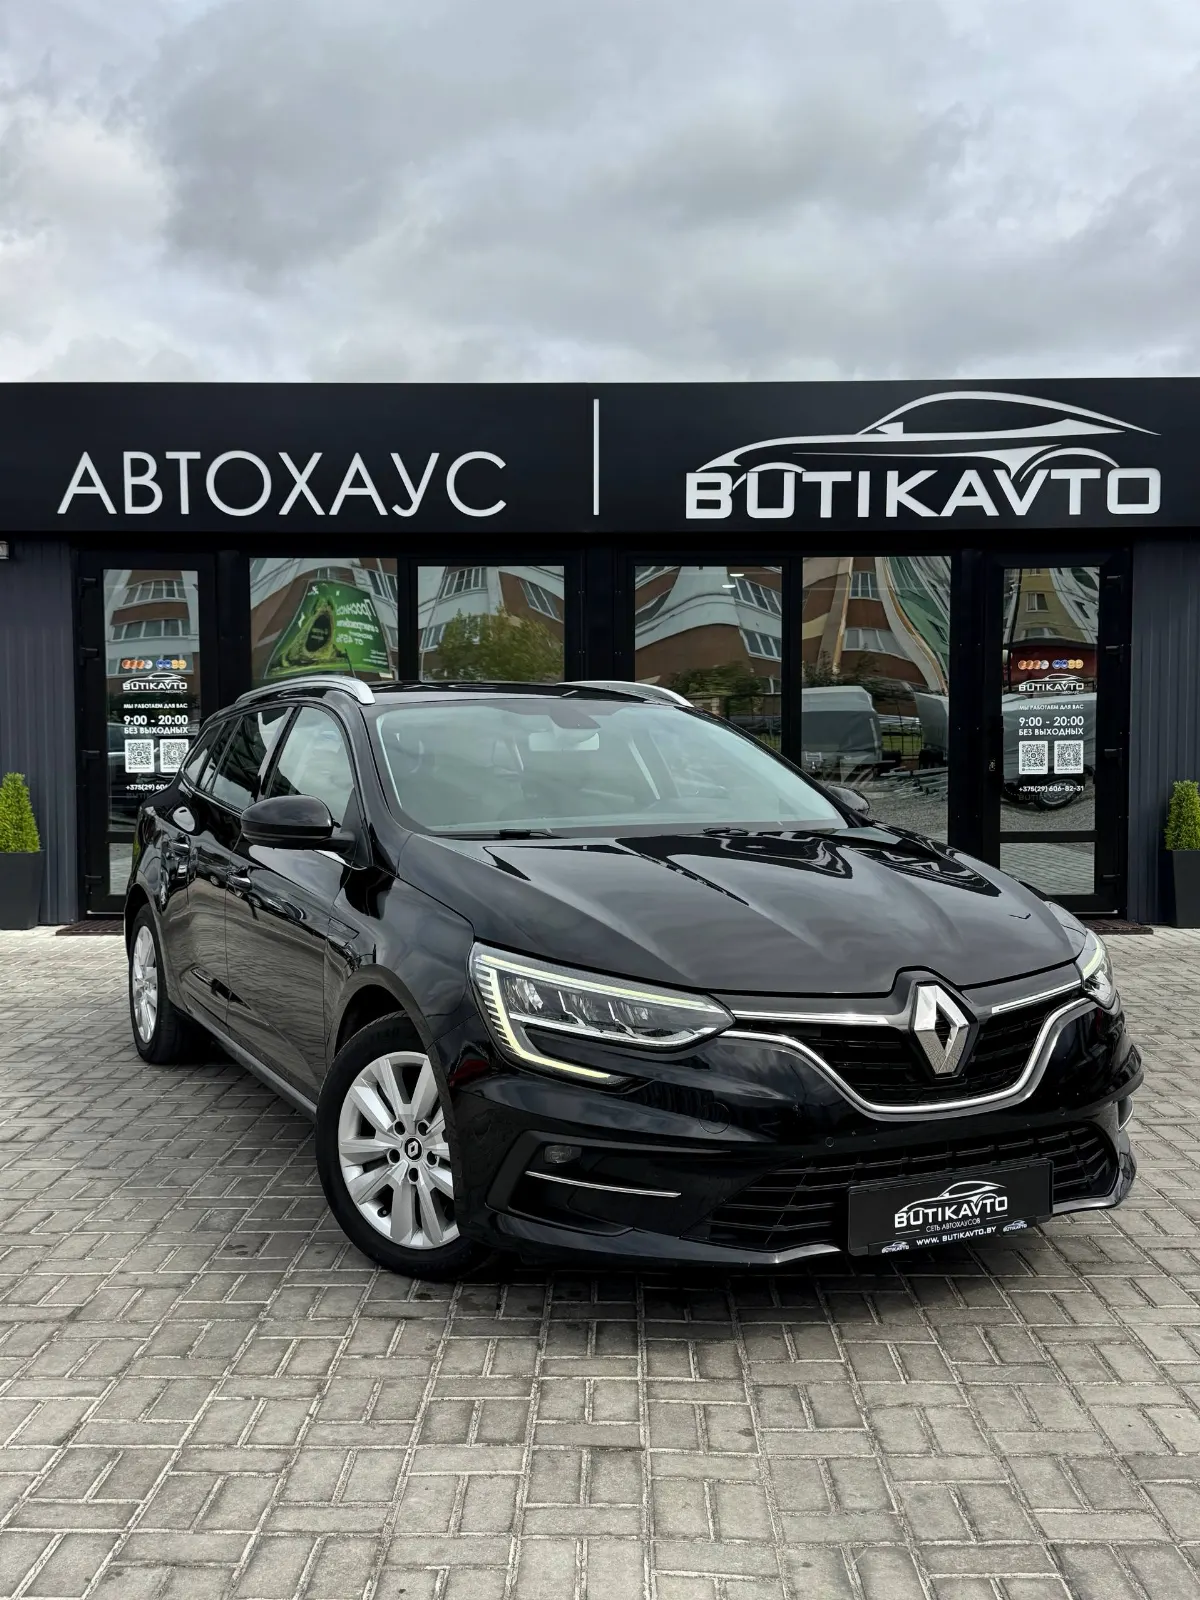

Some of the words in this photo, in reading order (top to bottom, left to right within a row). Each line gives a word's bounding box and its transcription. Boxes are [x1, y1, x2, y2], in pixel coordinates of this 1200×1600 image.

[57, 450, 506, 518] АВТОХАУС
[685, 467, 1161, 519] BUTIKAVTO
[123, 682, 188, 690] BUTIKAVTO
[1018, 682, 1084, 692] BUTIKAVTO
[123, 715, 148, 725] 9:00
[158, 714, 188, 725] 20:00
[1018, 716, 1043, 727] 9:00
[1053, 715, 1085, 726] 20:00
[124, 727, 138, 735] БЕЗ
[1018, 728, 1032, 736] БЕЗ
[894, 1196, 1008, 1228] BUTIKAVTO
[925, 1223, 941, 1233] СЕТЬ
[941, 1217, 981, 1231] АВТОХАУСОВ
[916, 1236, 940, 1246] WWW.
[942, 1226, 997, 1242] BUTIKAVTO.BY
